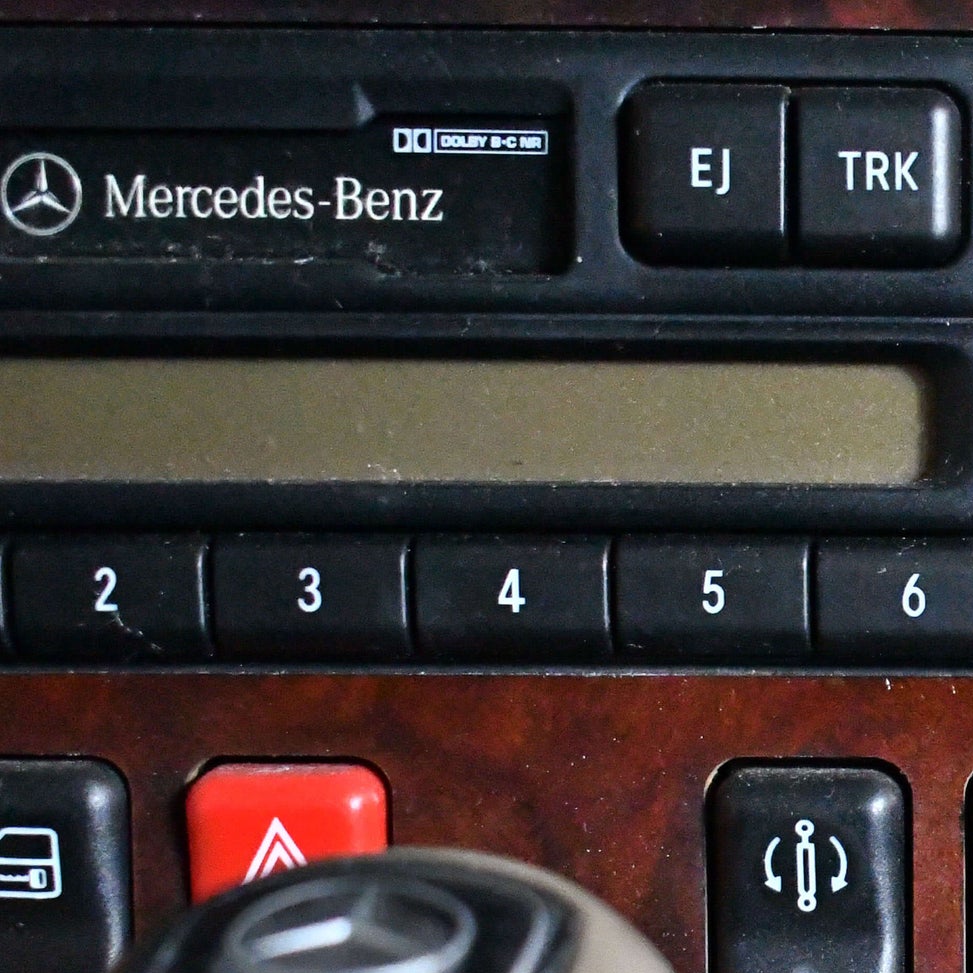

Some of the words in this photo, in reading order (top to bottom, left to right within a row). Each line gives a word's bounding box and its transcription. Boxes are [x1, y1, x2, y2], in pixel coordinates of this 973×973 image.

[440, 135, 488, 148] DOLBY
[519, 136, 542, 149] NR
[691, 147, 730, 195] EJ
[837, 150, 919, 191] TRK
[105, 174, 444, 221] Mercedes-Benz
[94, 566, 118, 612] 2
[297, 567, 322, 613] 3
[497, 568, 526, 613] 4
[702, 569, 725, 614] 5
[901, 573, 926, 618] 6
